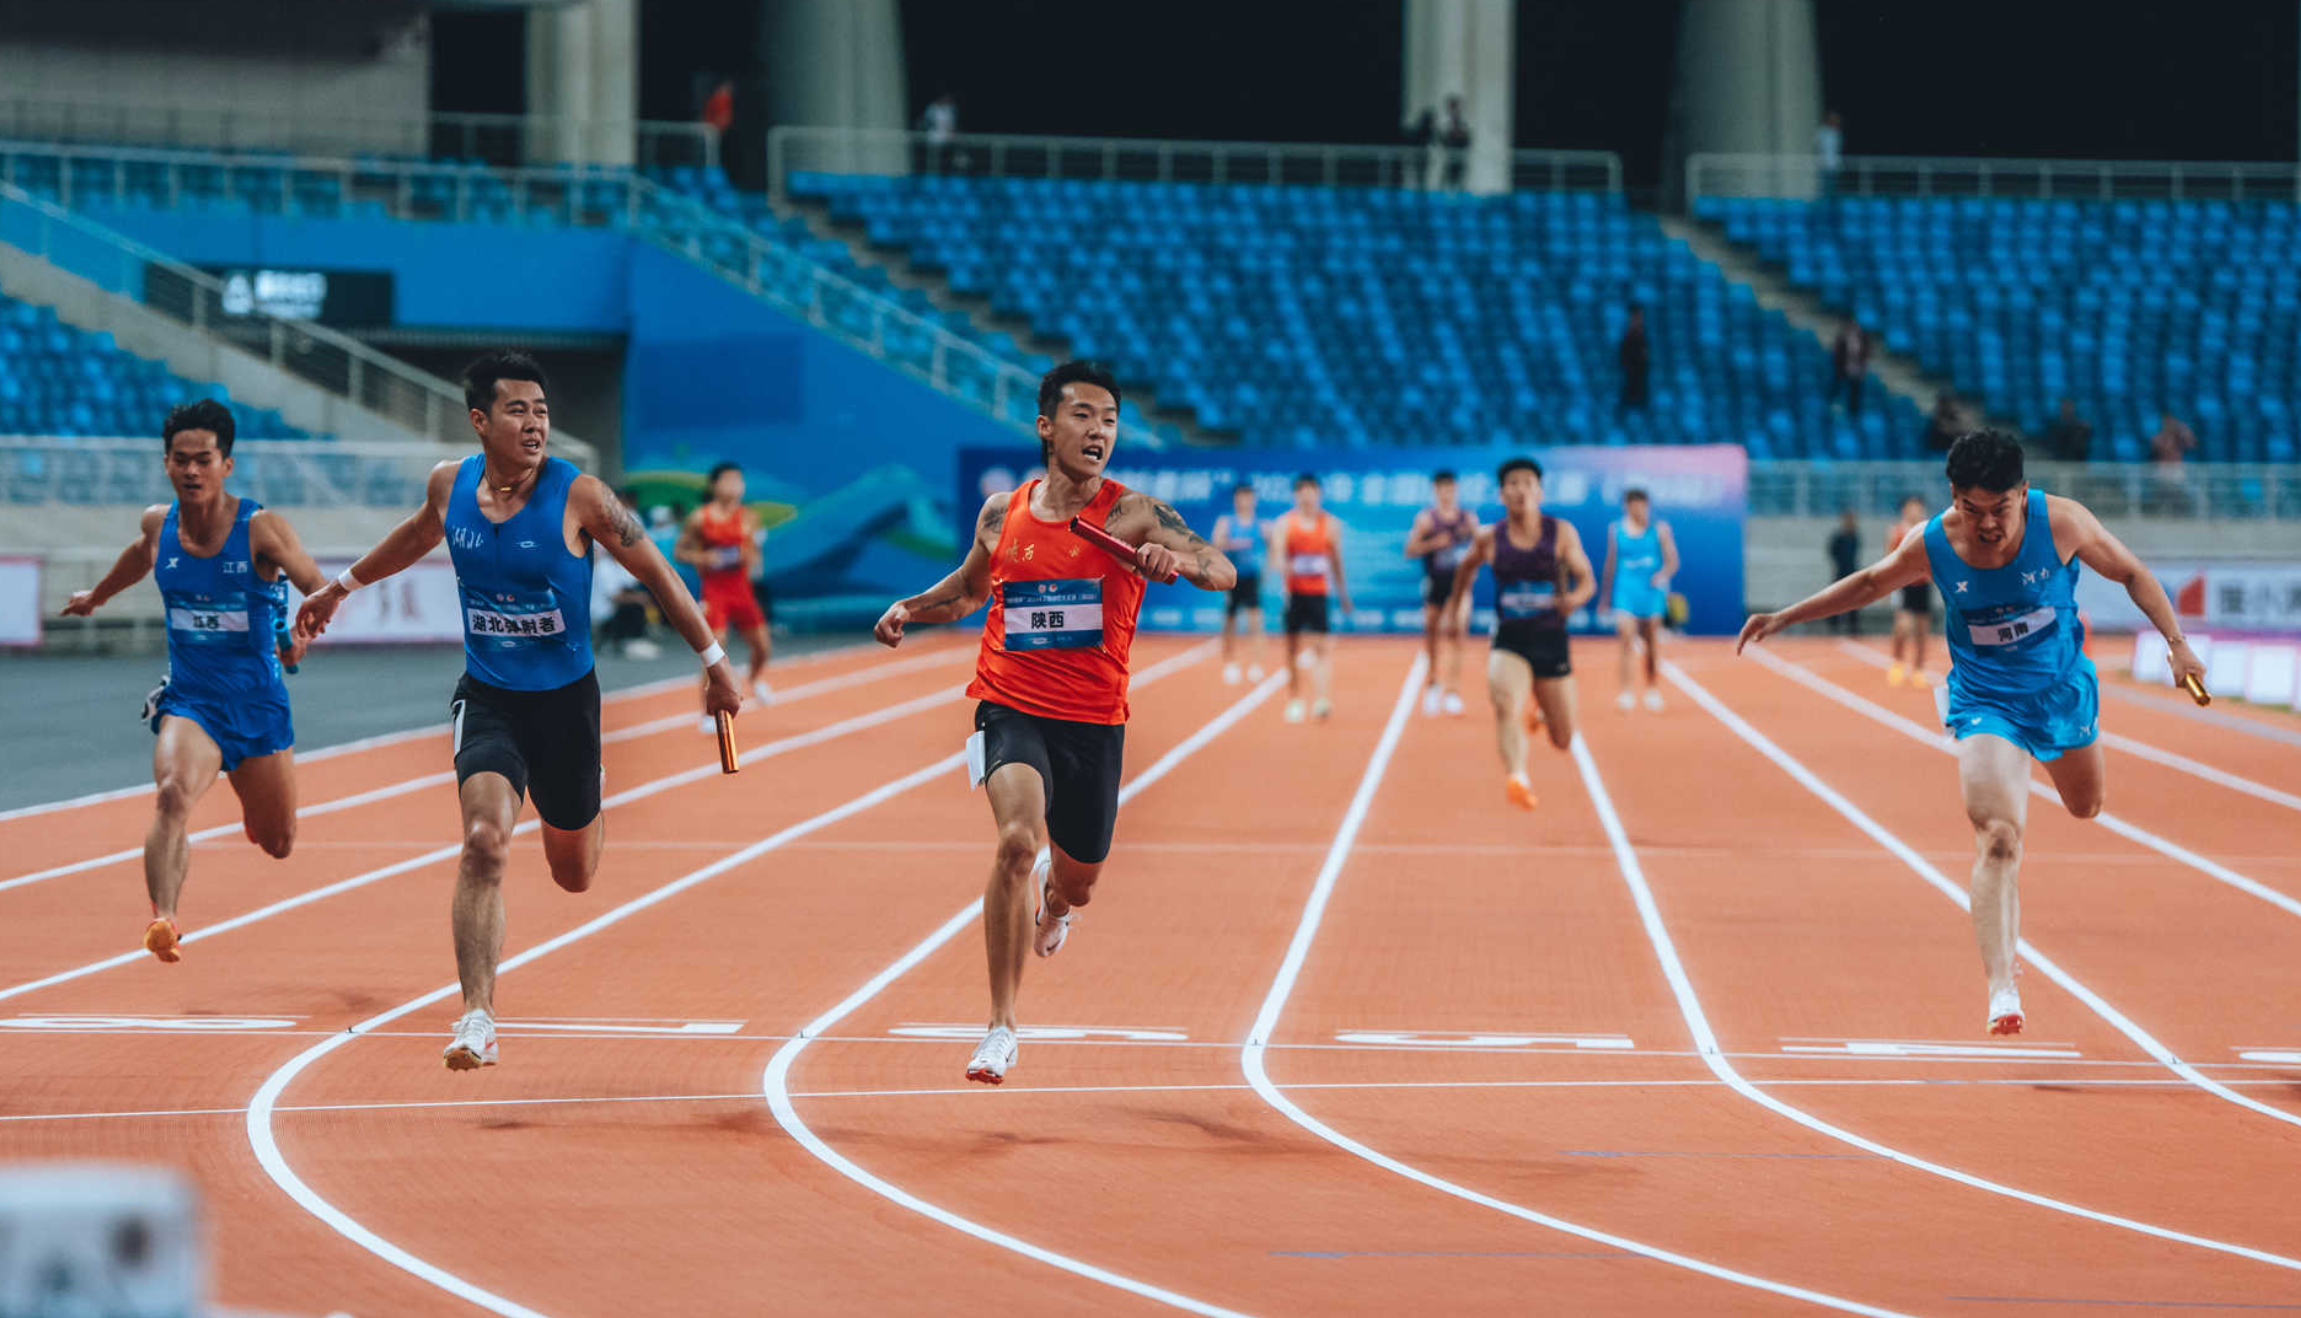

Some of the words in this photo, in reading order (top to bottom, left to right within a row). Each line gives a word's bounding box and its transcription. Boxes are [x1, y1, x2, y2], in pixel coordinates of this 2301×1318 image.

[223, 560, 248, 573] 江西
[1031, 611, 1064, 629] 陕西
[1998, 621, 2029, 642] 河南
